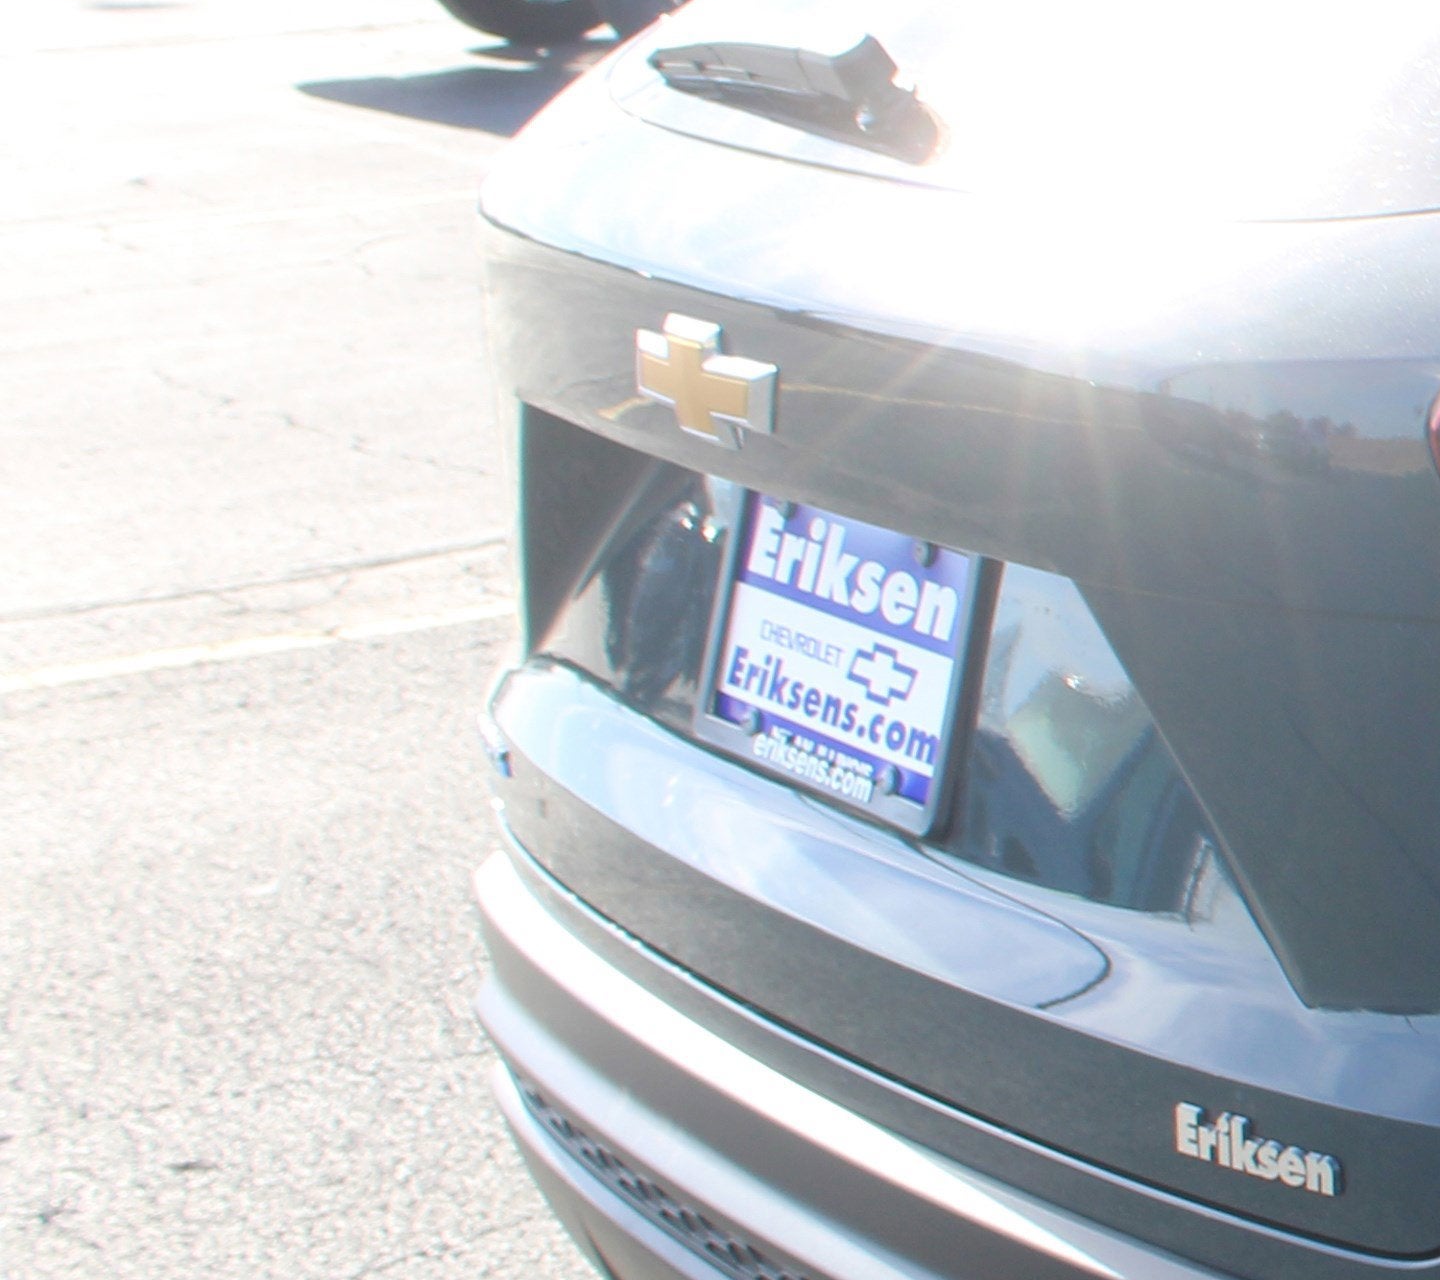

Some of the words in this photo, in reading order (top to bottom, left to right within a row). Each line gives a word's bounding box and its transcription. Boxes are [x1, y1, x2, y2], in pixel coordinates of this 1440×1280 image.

[748, 502, 959, 642] Eriksen
[760, 618, 846, 669] CHEVROLET
[725, 645, 940, 765] Eriksens.com
[752, 732, 874, 803] eriksens.com
[1175, 1101, 1341, 1197] Eriksen
